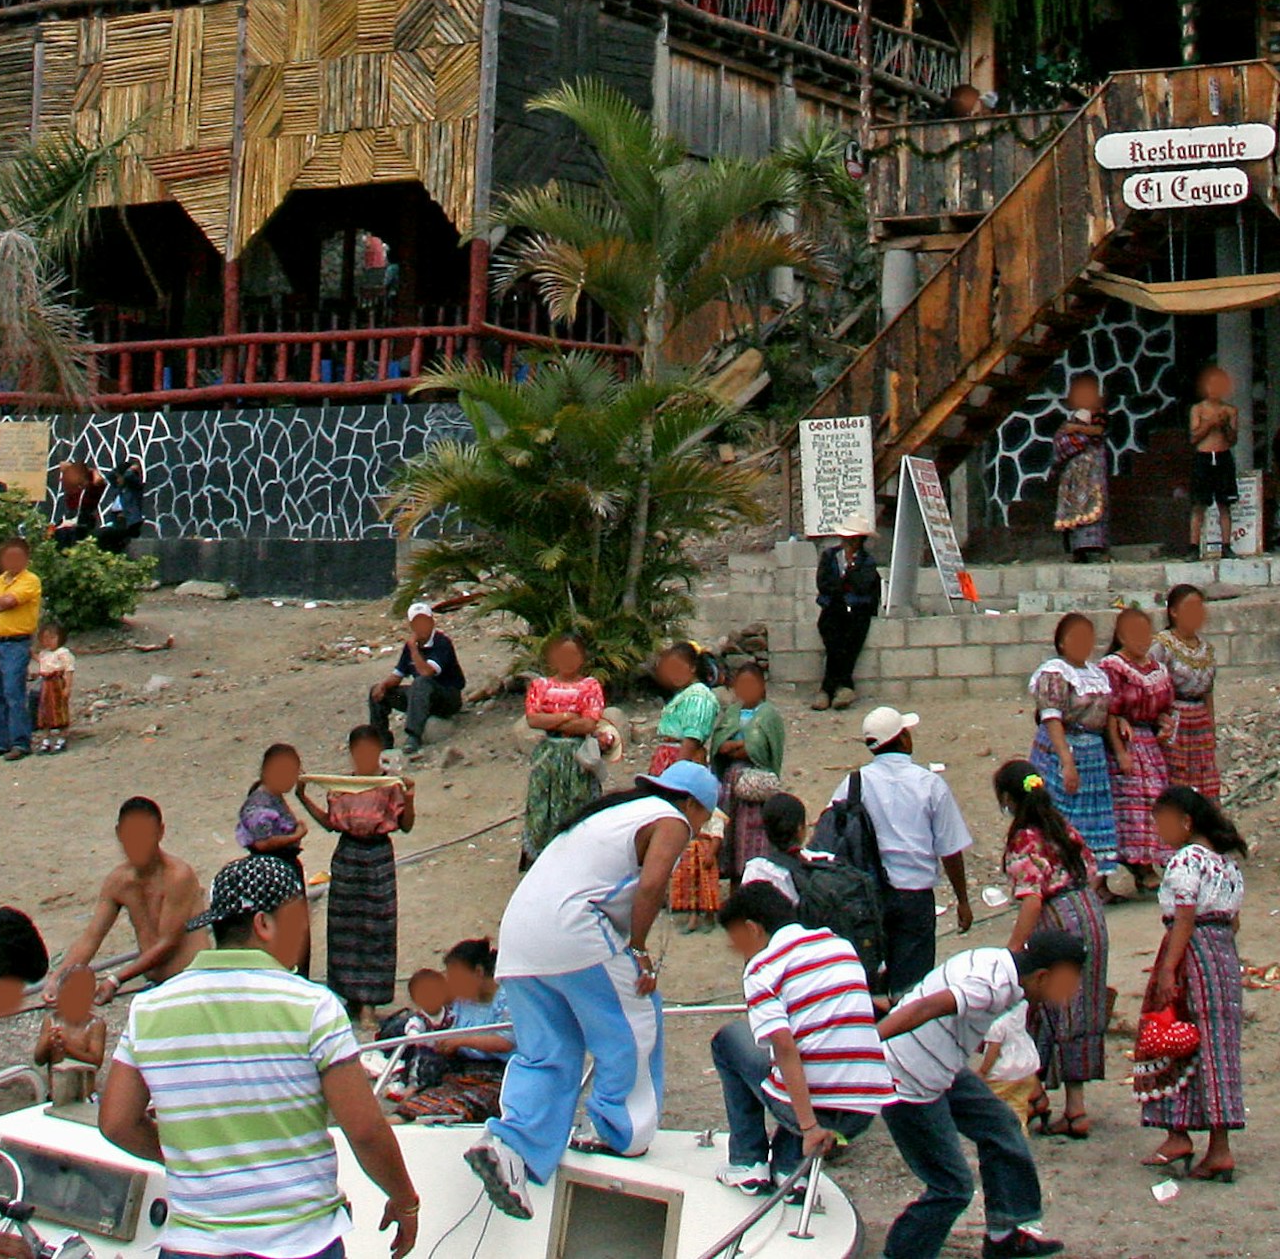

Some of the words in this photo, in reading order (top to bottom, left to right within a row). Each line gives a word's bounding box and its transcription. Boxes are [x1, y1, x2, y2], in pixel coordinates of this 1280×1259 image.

[1129, 137, 1247, 164] Restaurante
[1134, 178, 1162, 204] El
[1171, 175, 1244, 204] Cayuco
